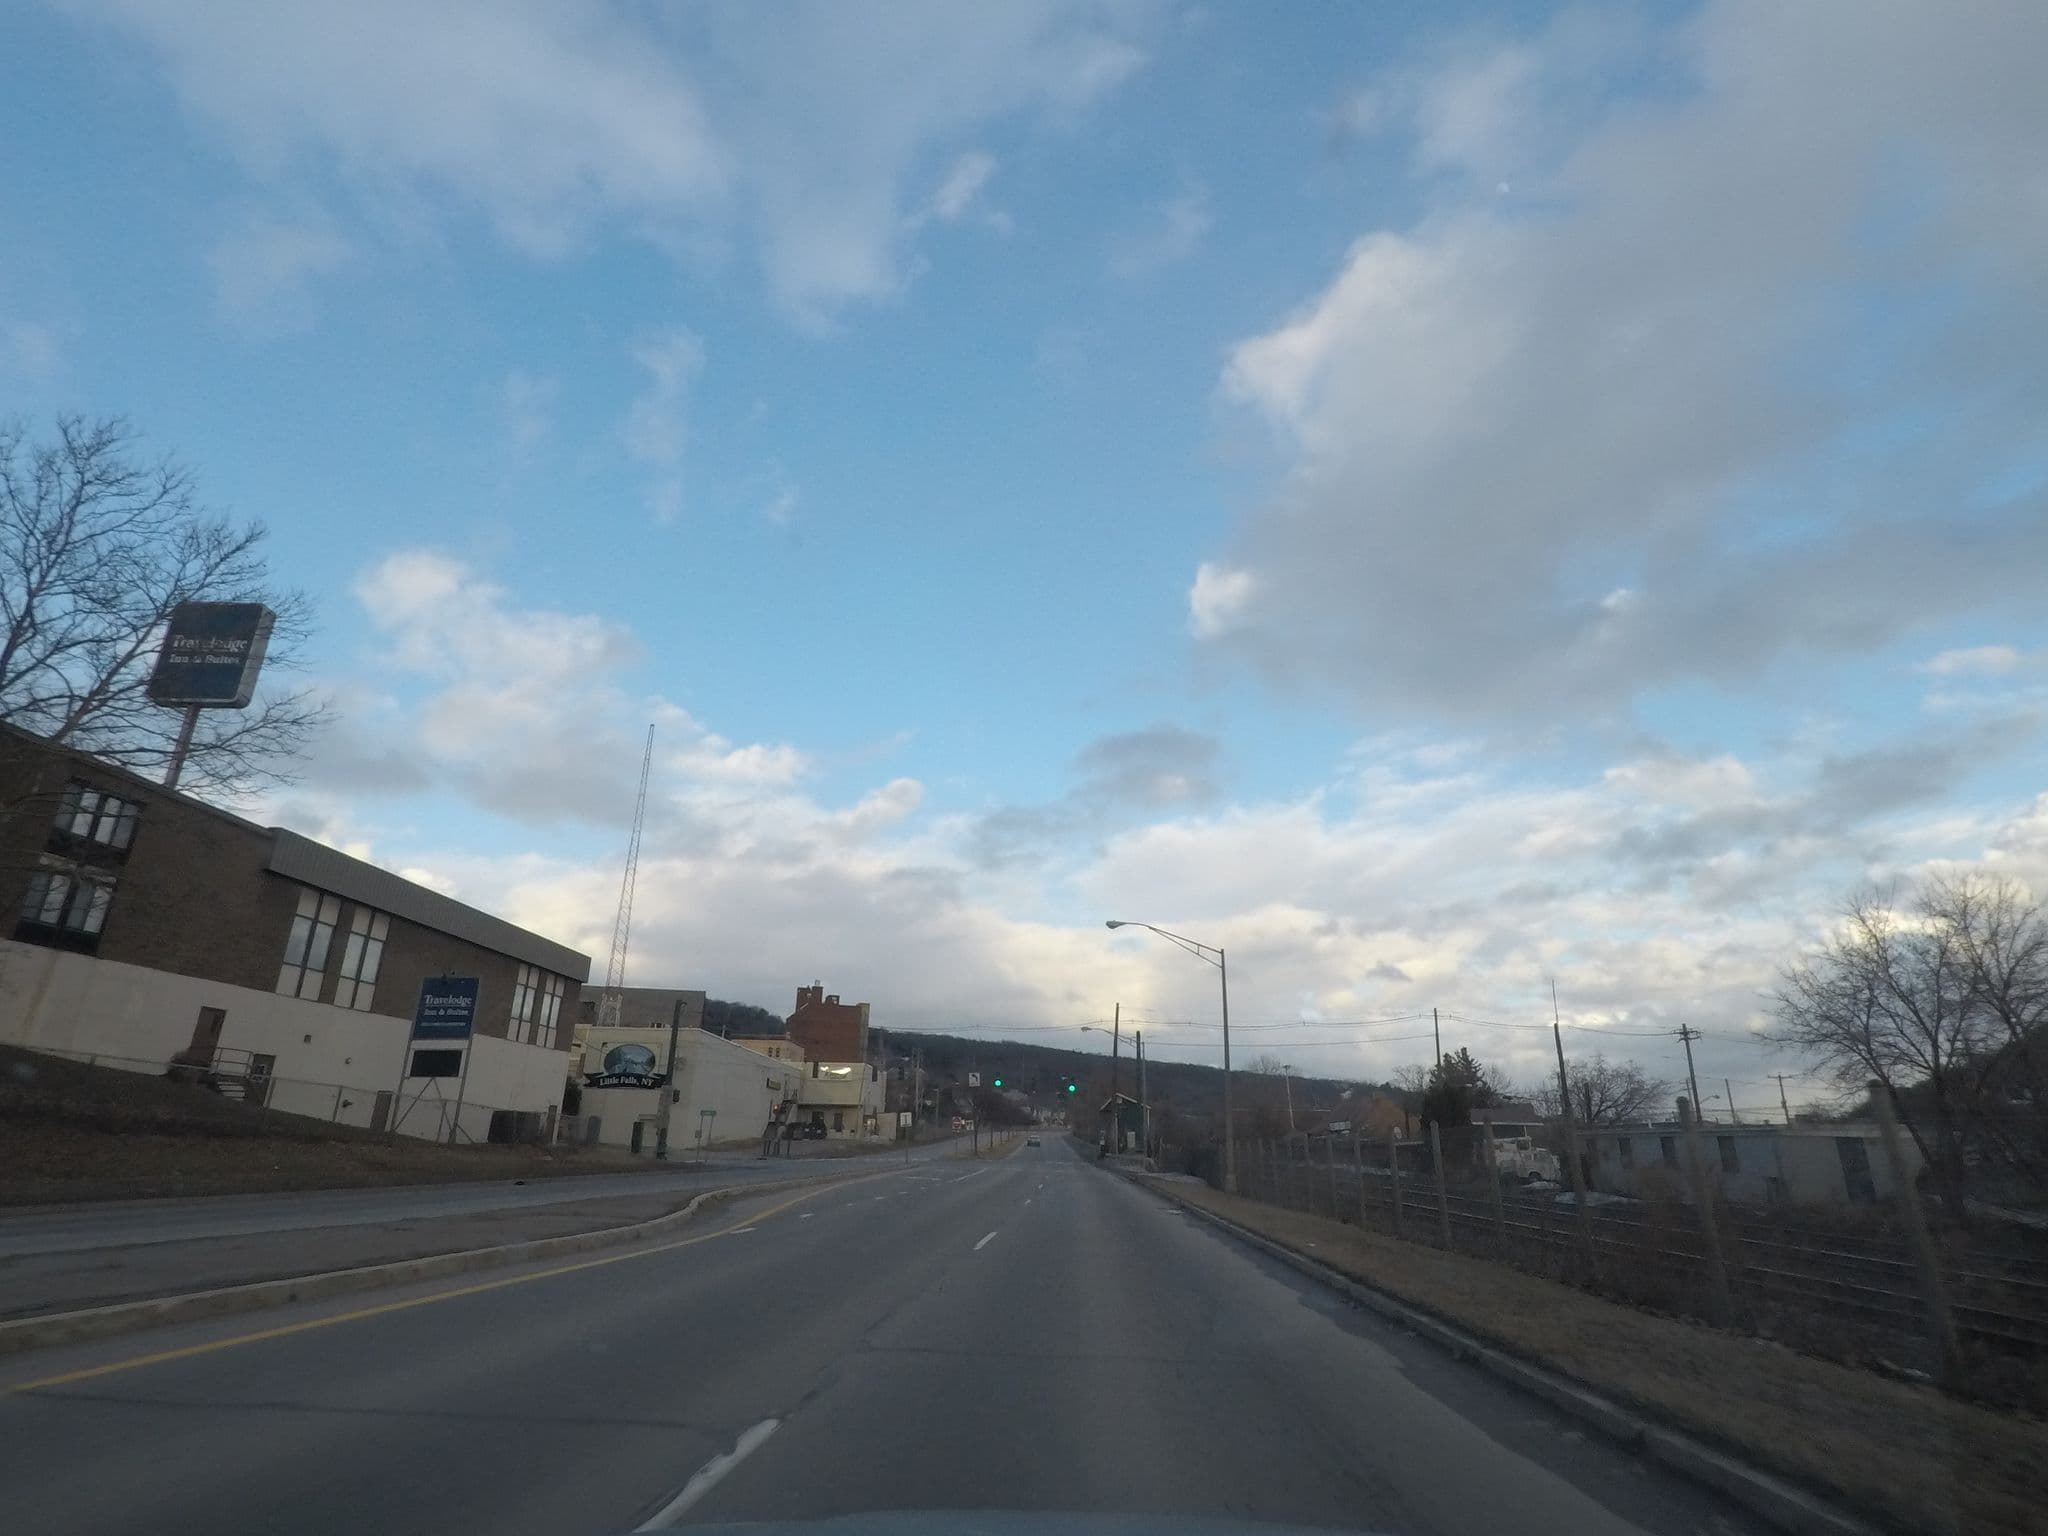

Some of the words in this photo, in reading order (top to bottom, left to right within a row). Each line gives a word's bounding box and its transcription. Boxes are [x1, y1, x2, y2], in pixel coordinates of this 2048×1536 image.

[169, 654, 189, 663] Inn
[205, 654, 240, 664] Suites
[424, 994, 473, 1007] Travelodge
[424, 1008, 438, 1016] Inn
[438, 1008, 446, 1016] &
[446, 1008, 469, 1016] Suites
[599, 1076, 619, 1086] Little
[620, 1076, 640, 1086] Falls,
[640, 1077, 655, 1087] NY
